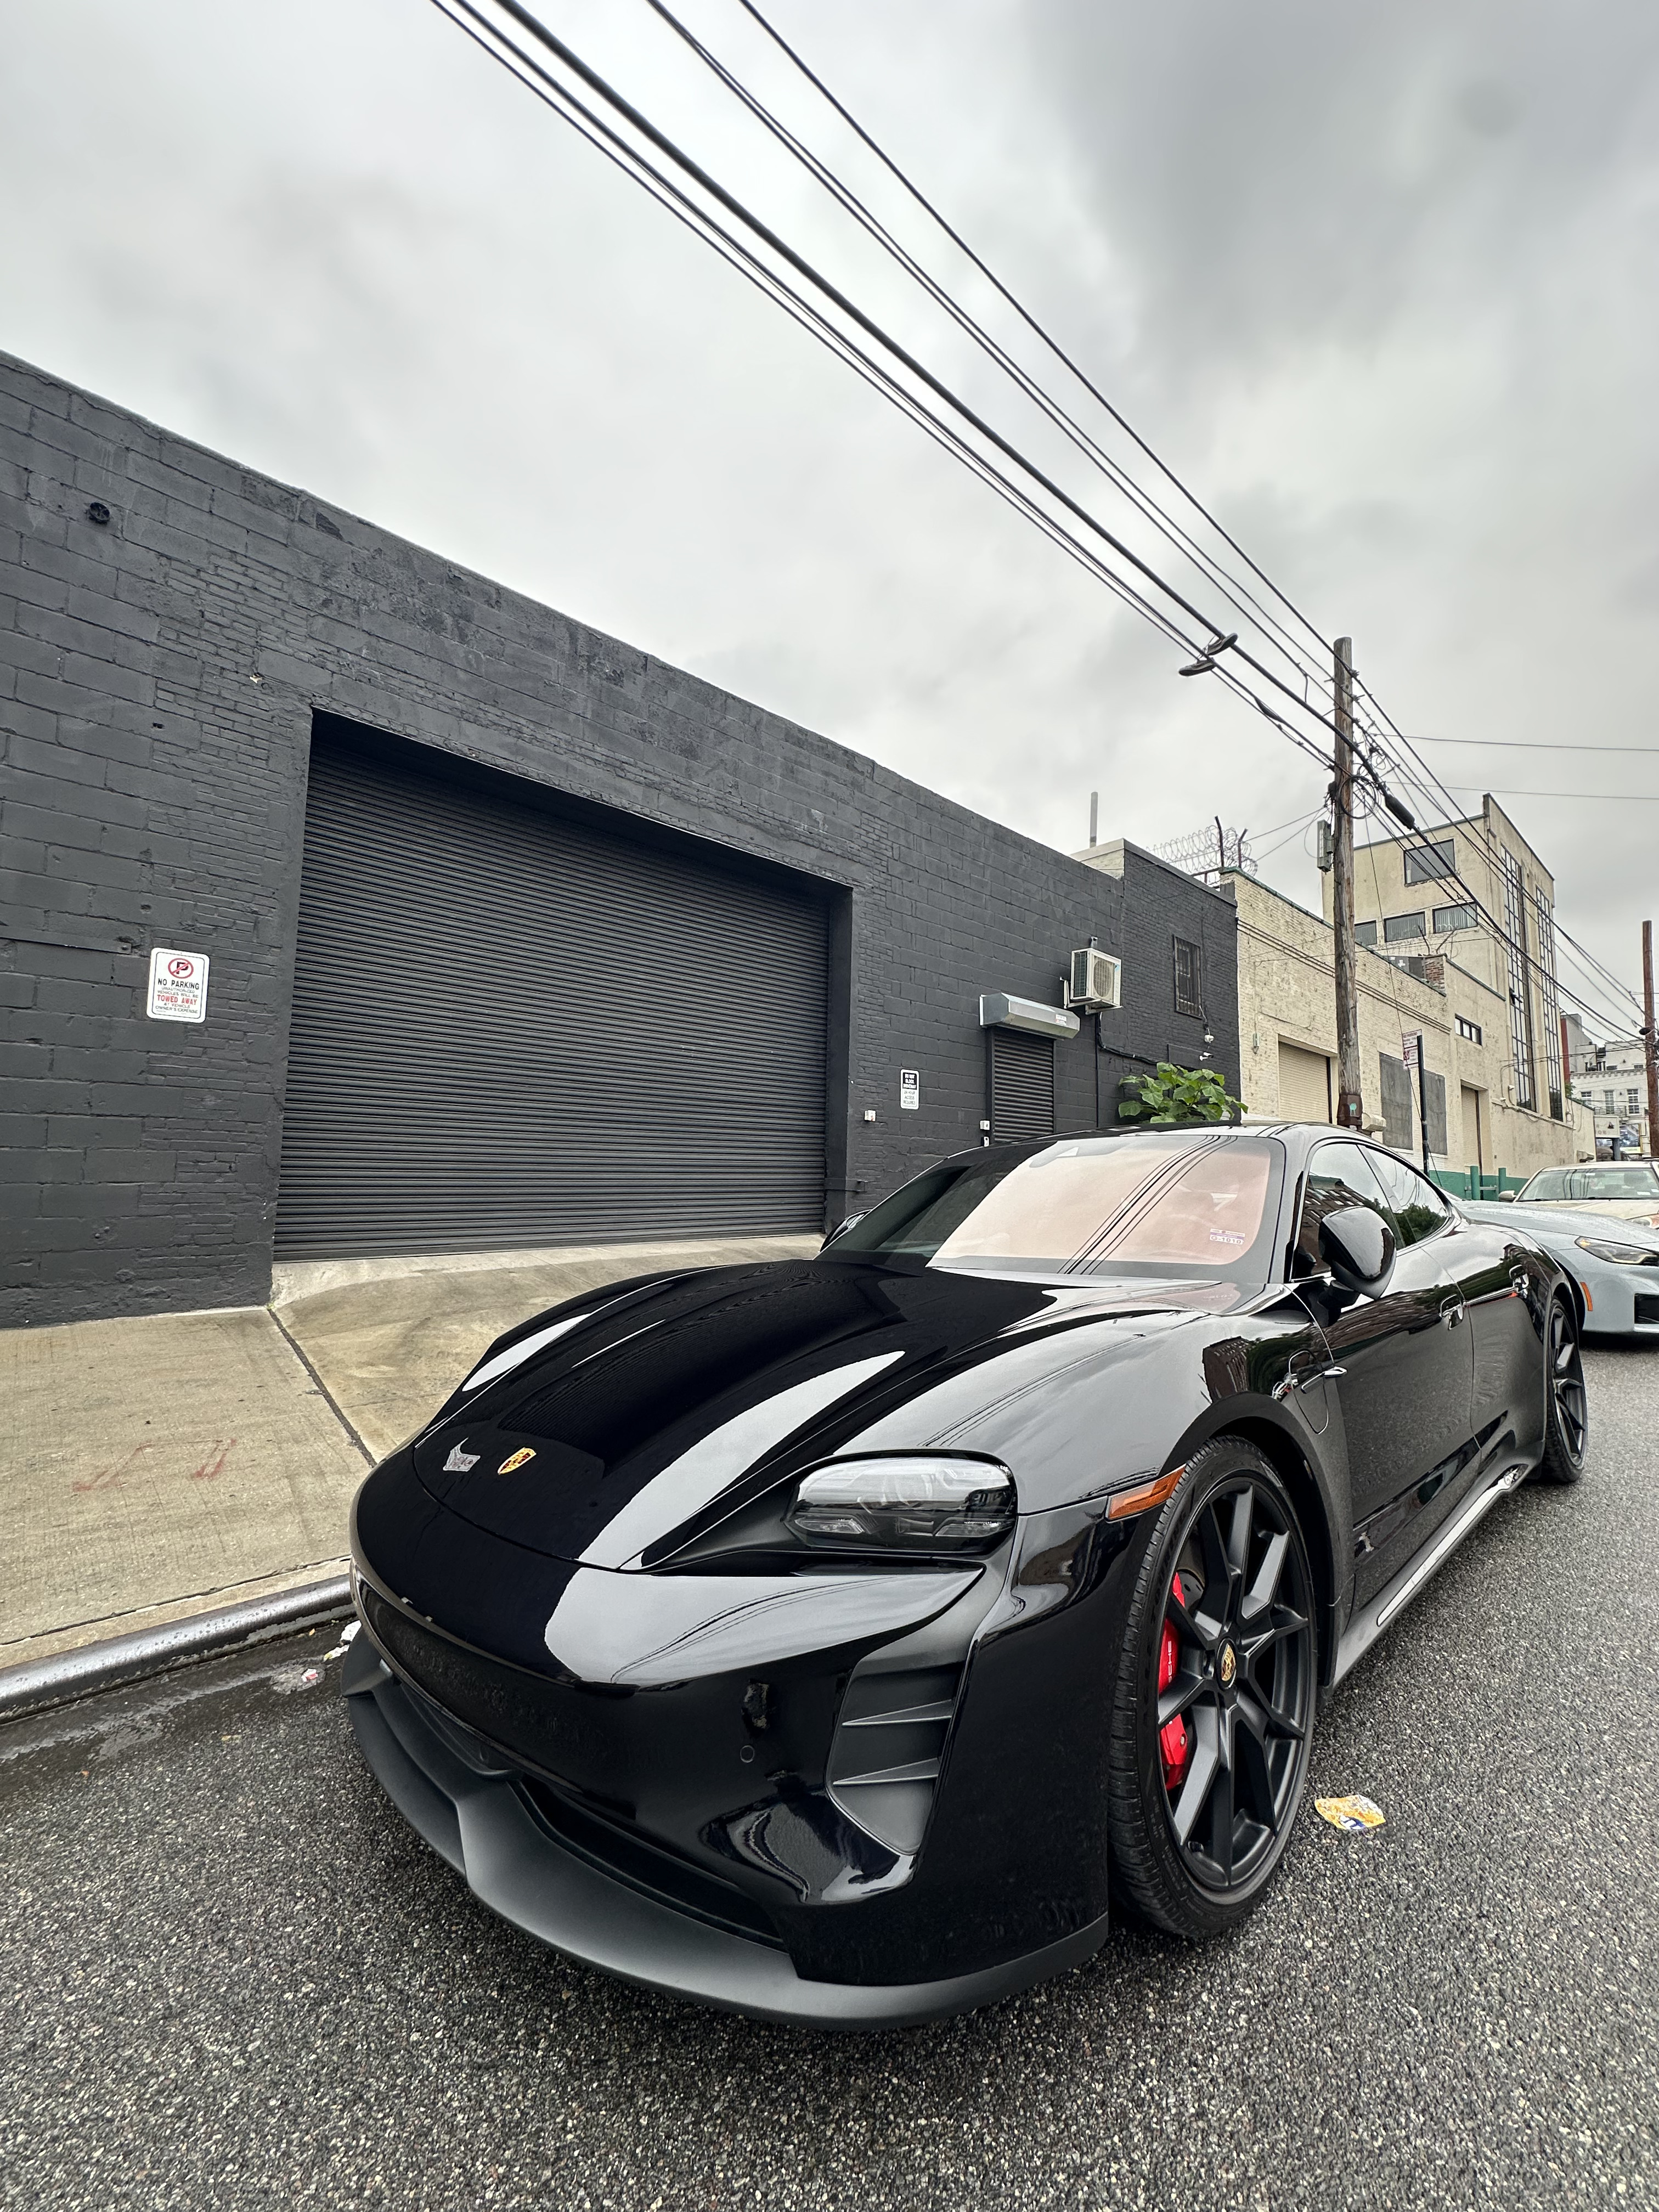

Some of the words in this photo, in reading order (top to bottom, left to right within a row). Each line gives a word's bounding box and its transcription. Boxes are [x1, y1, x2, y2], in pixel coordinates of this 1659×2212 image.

[157, 978, 167, 986] NO
[171, 980, 200, 990] PARKING
[157, 994, 178, 1003] TOWED
